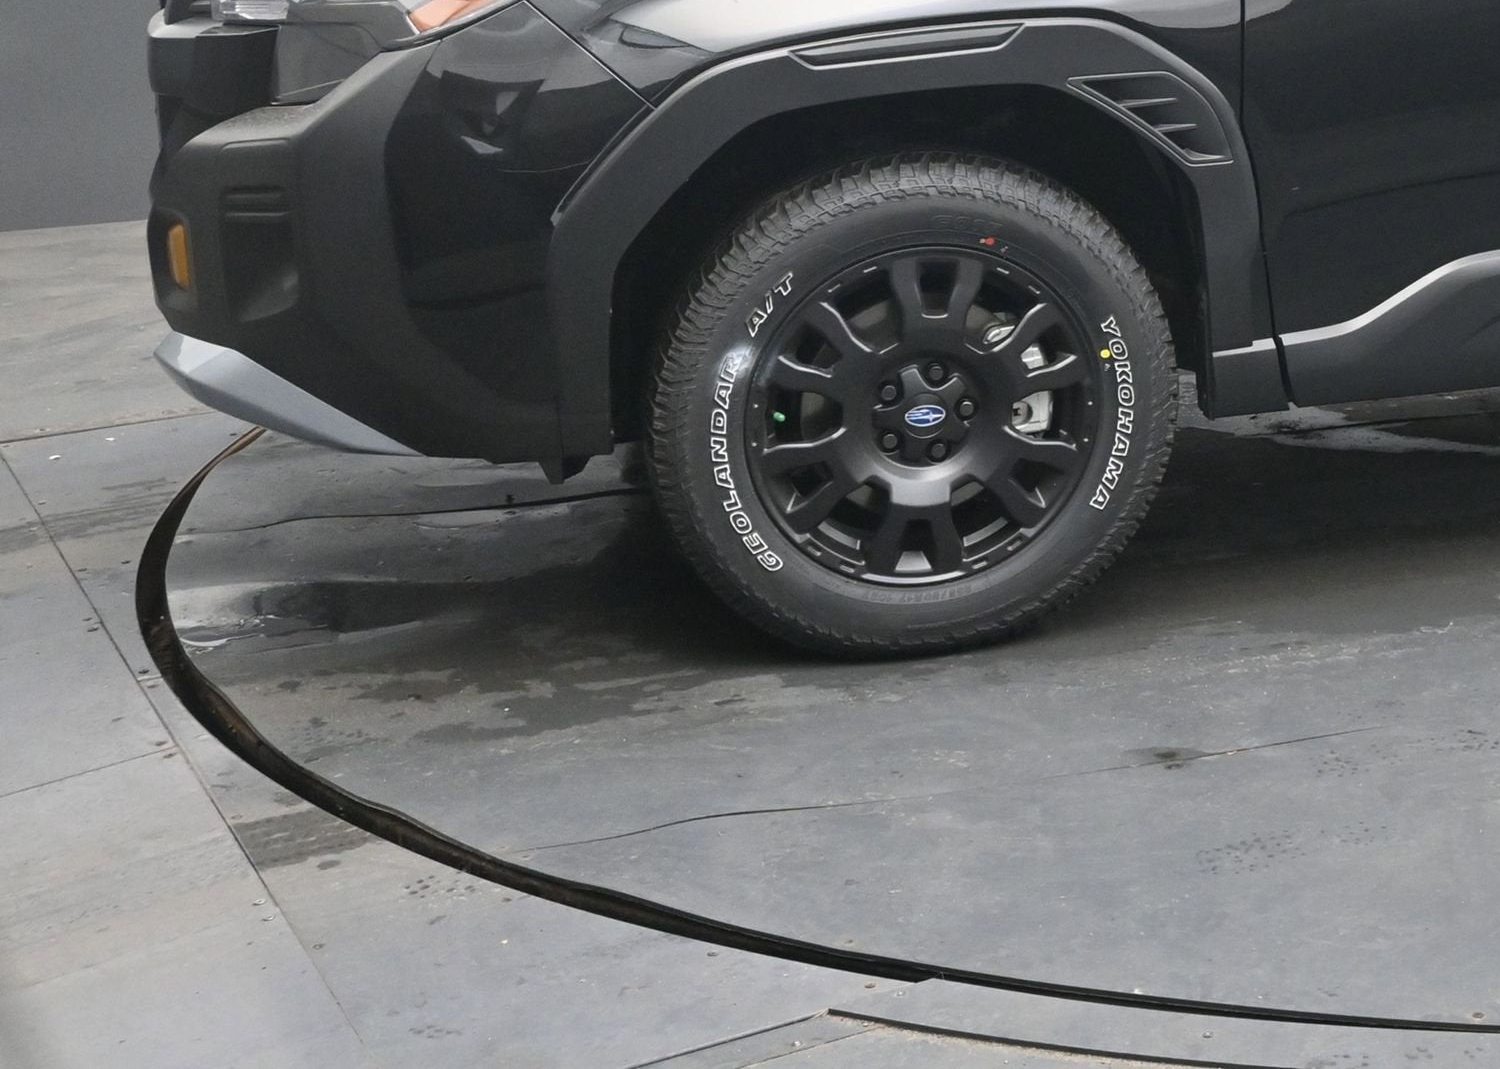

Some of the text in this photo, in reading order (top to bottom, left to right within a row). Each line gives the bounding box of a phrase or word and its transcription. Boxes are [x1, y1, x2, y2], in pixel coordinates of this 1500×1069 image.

[710, 269, 794, 571] GEOLANDAR A/T
[1089, 316, 1135, 510] YOKOHAMA
